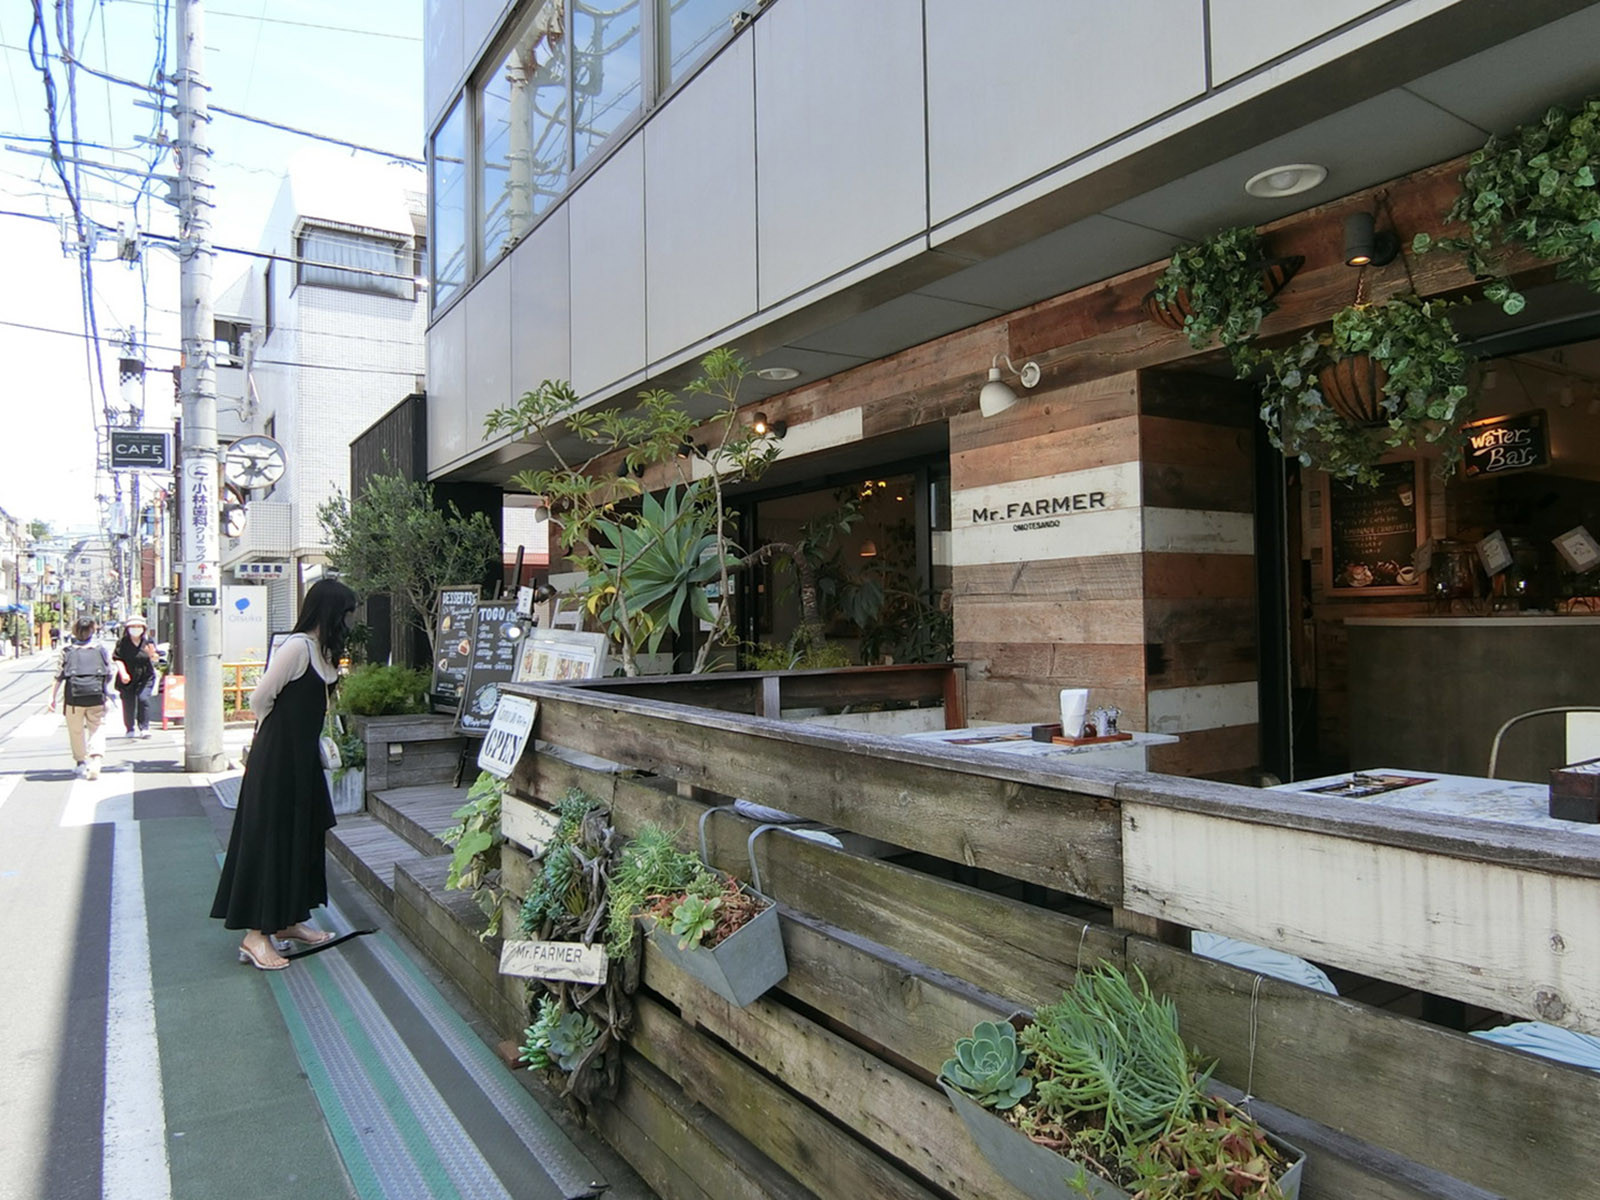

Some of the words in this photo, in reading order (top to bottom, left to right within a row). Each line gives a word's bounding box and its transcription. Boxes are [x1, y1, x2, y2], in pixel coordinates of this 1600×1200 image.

[115, 443, 163, 455] CAFE
[1486, 447, 1535, 470] Bar
[1012, 520, 1061, 532] OMOTESANDO
[485, 728, 523, 765] OPEN
